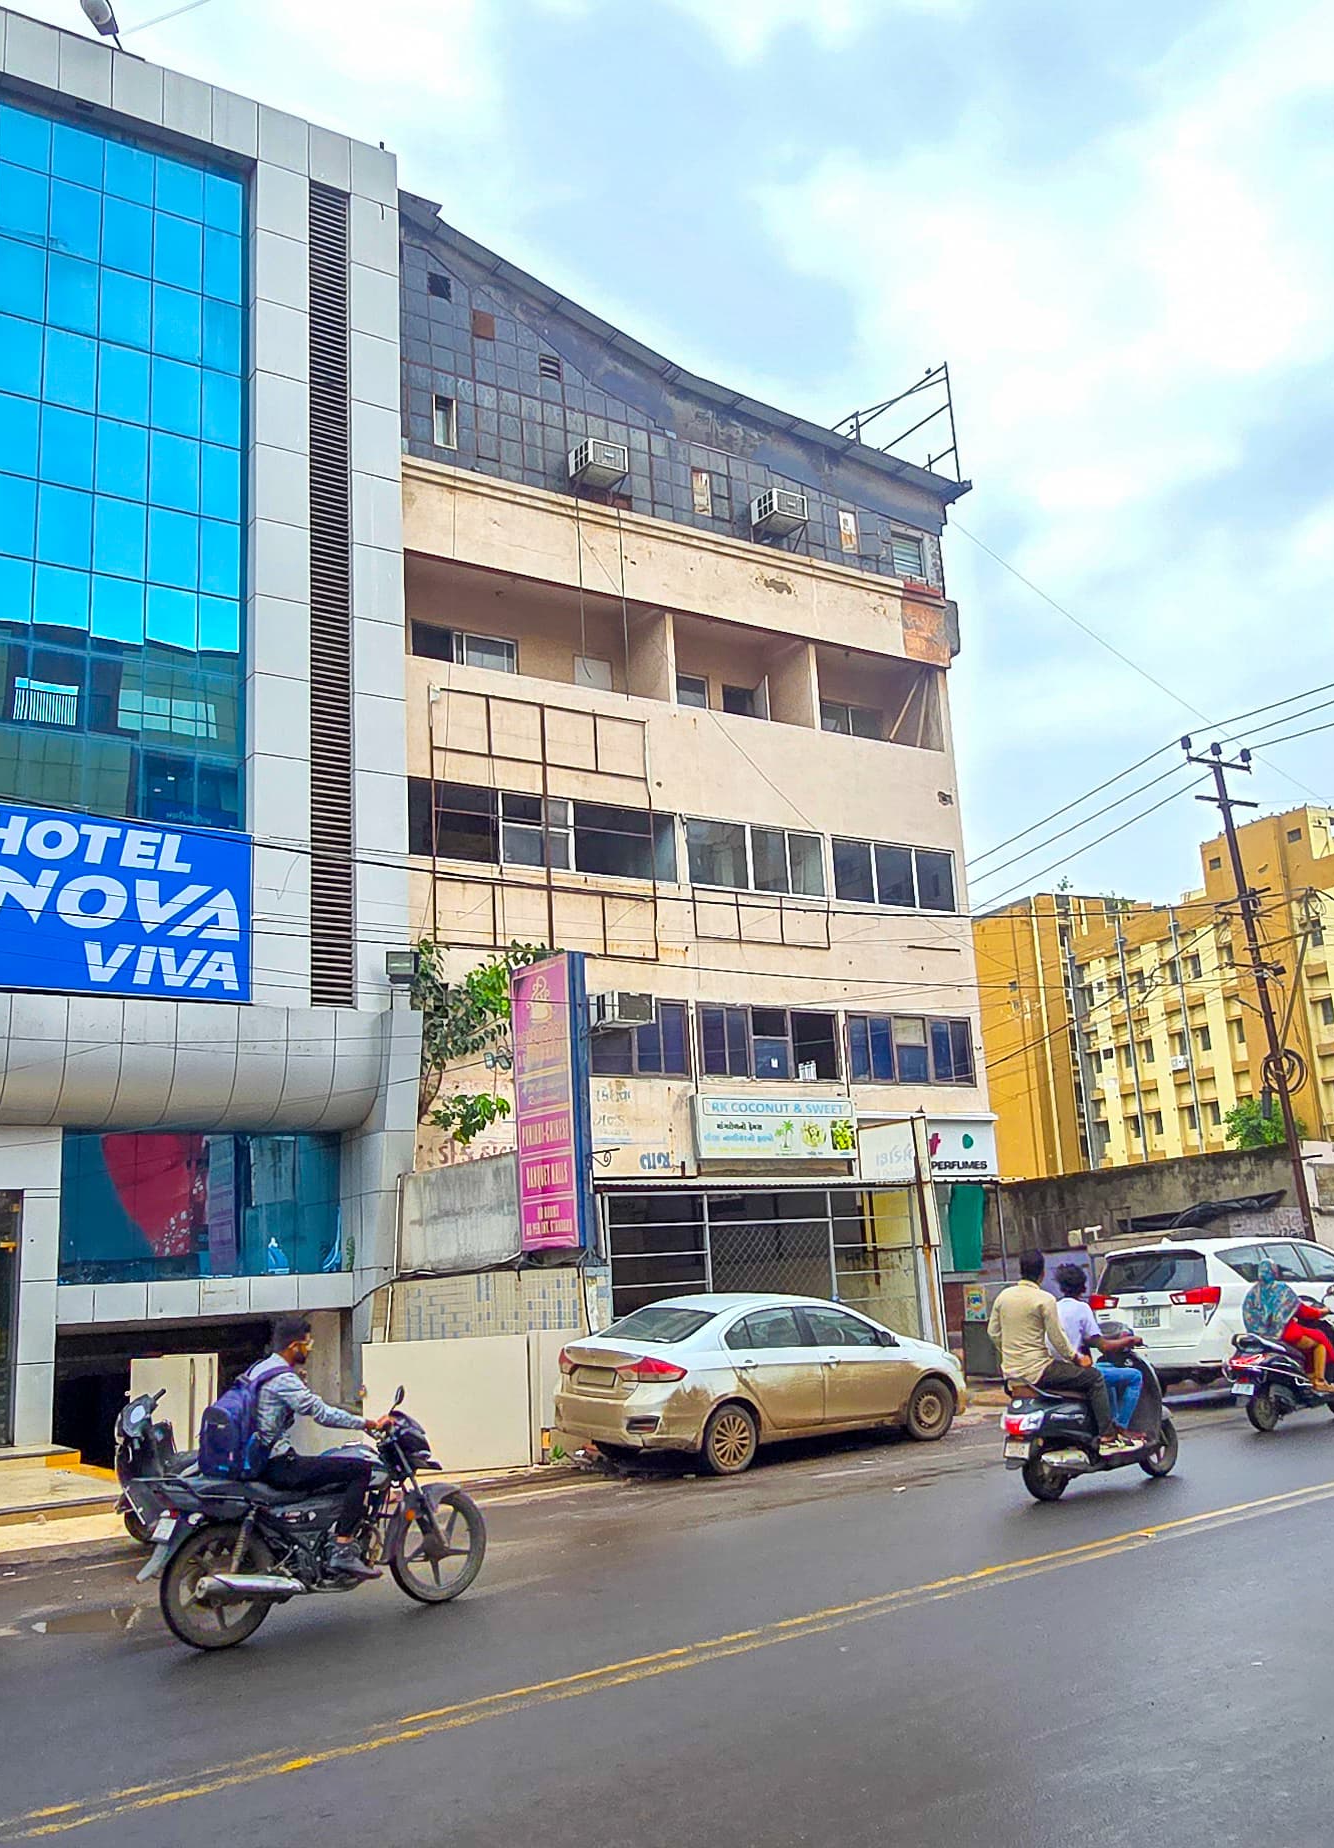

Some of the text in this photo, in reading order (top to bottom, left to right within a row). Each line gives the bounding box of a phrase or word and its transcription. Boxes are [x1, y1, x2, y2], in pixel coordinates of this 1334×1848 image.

[84, 940, 240, 991] VIVA
[711, 1102, 844, 1115] RK COCONUT & SWEET
[931, 1160, 987, 1170] PERFUMES
